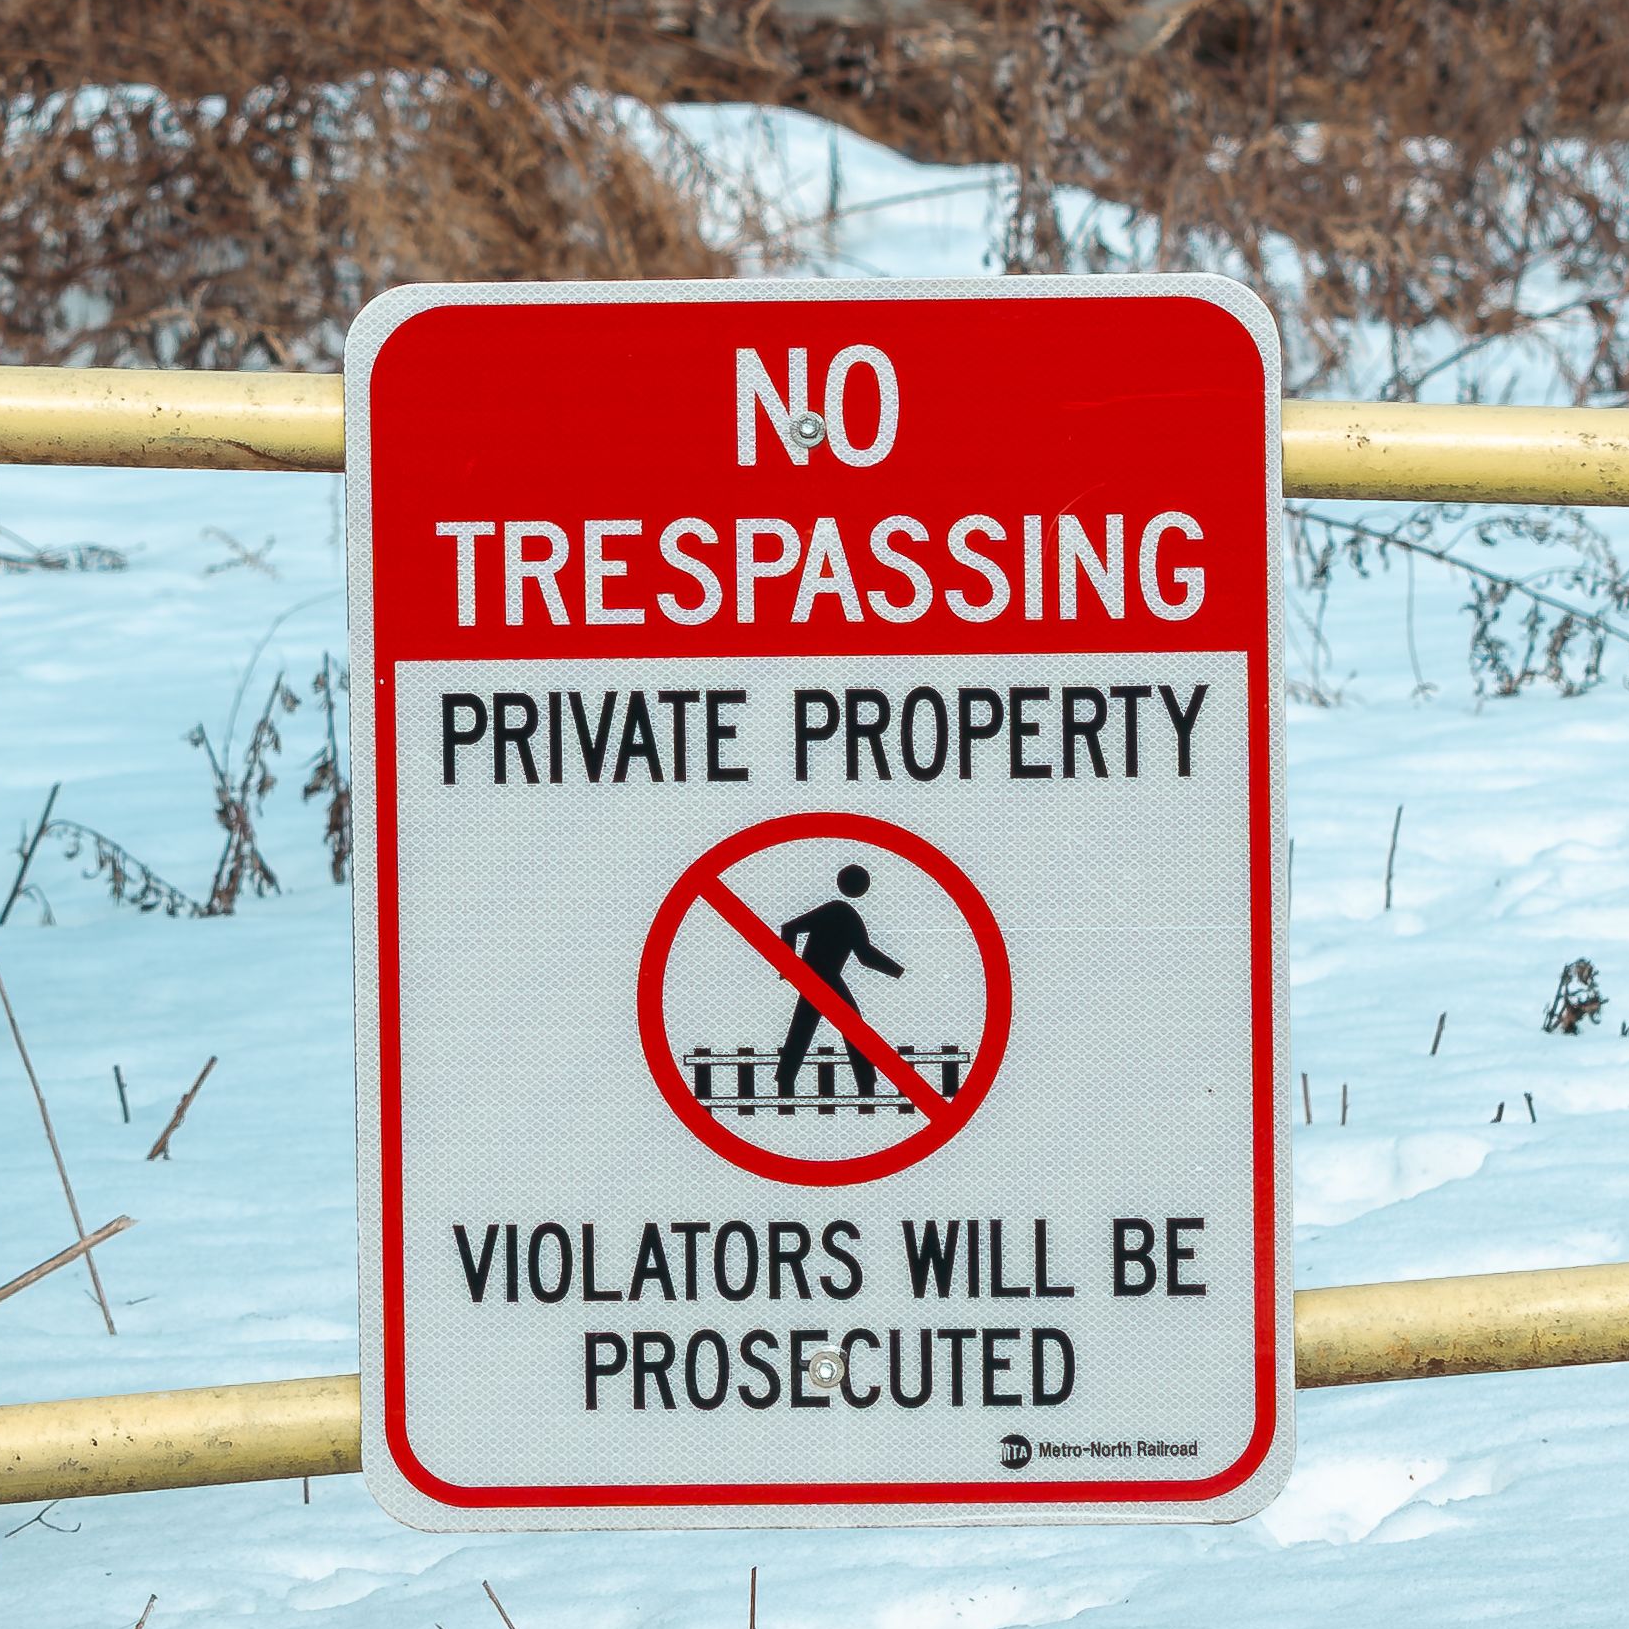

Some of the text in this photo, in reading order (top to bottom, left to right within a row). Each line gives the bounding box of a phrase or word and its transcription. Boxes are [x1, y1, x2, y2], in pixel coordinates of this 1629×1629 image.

[735, 344, 901, 468] NO
[436, 511, 1208, 627] TRESPASSING
[441, 685, 1211, 785] PRIVATE PROPERTY
[453, 1217, 1208, 1303] VIOLATORS WILL BE
[584, 1328, 1077, 1412] PROSECUTED
[1039, 1442, 1131, 1458] Metro-North
[1137, 1441, 1198, 1456] Railroad
